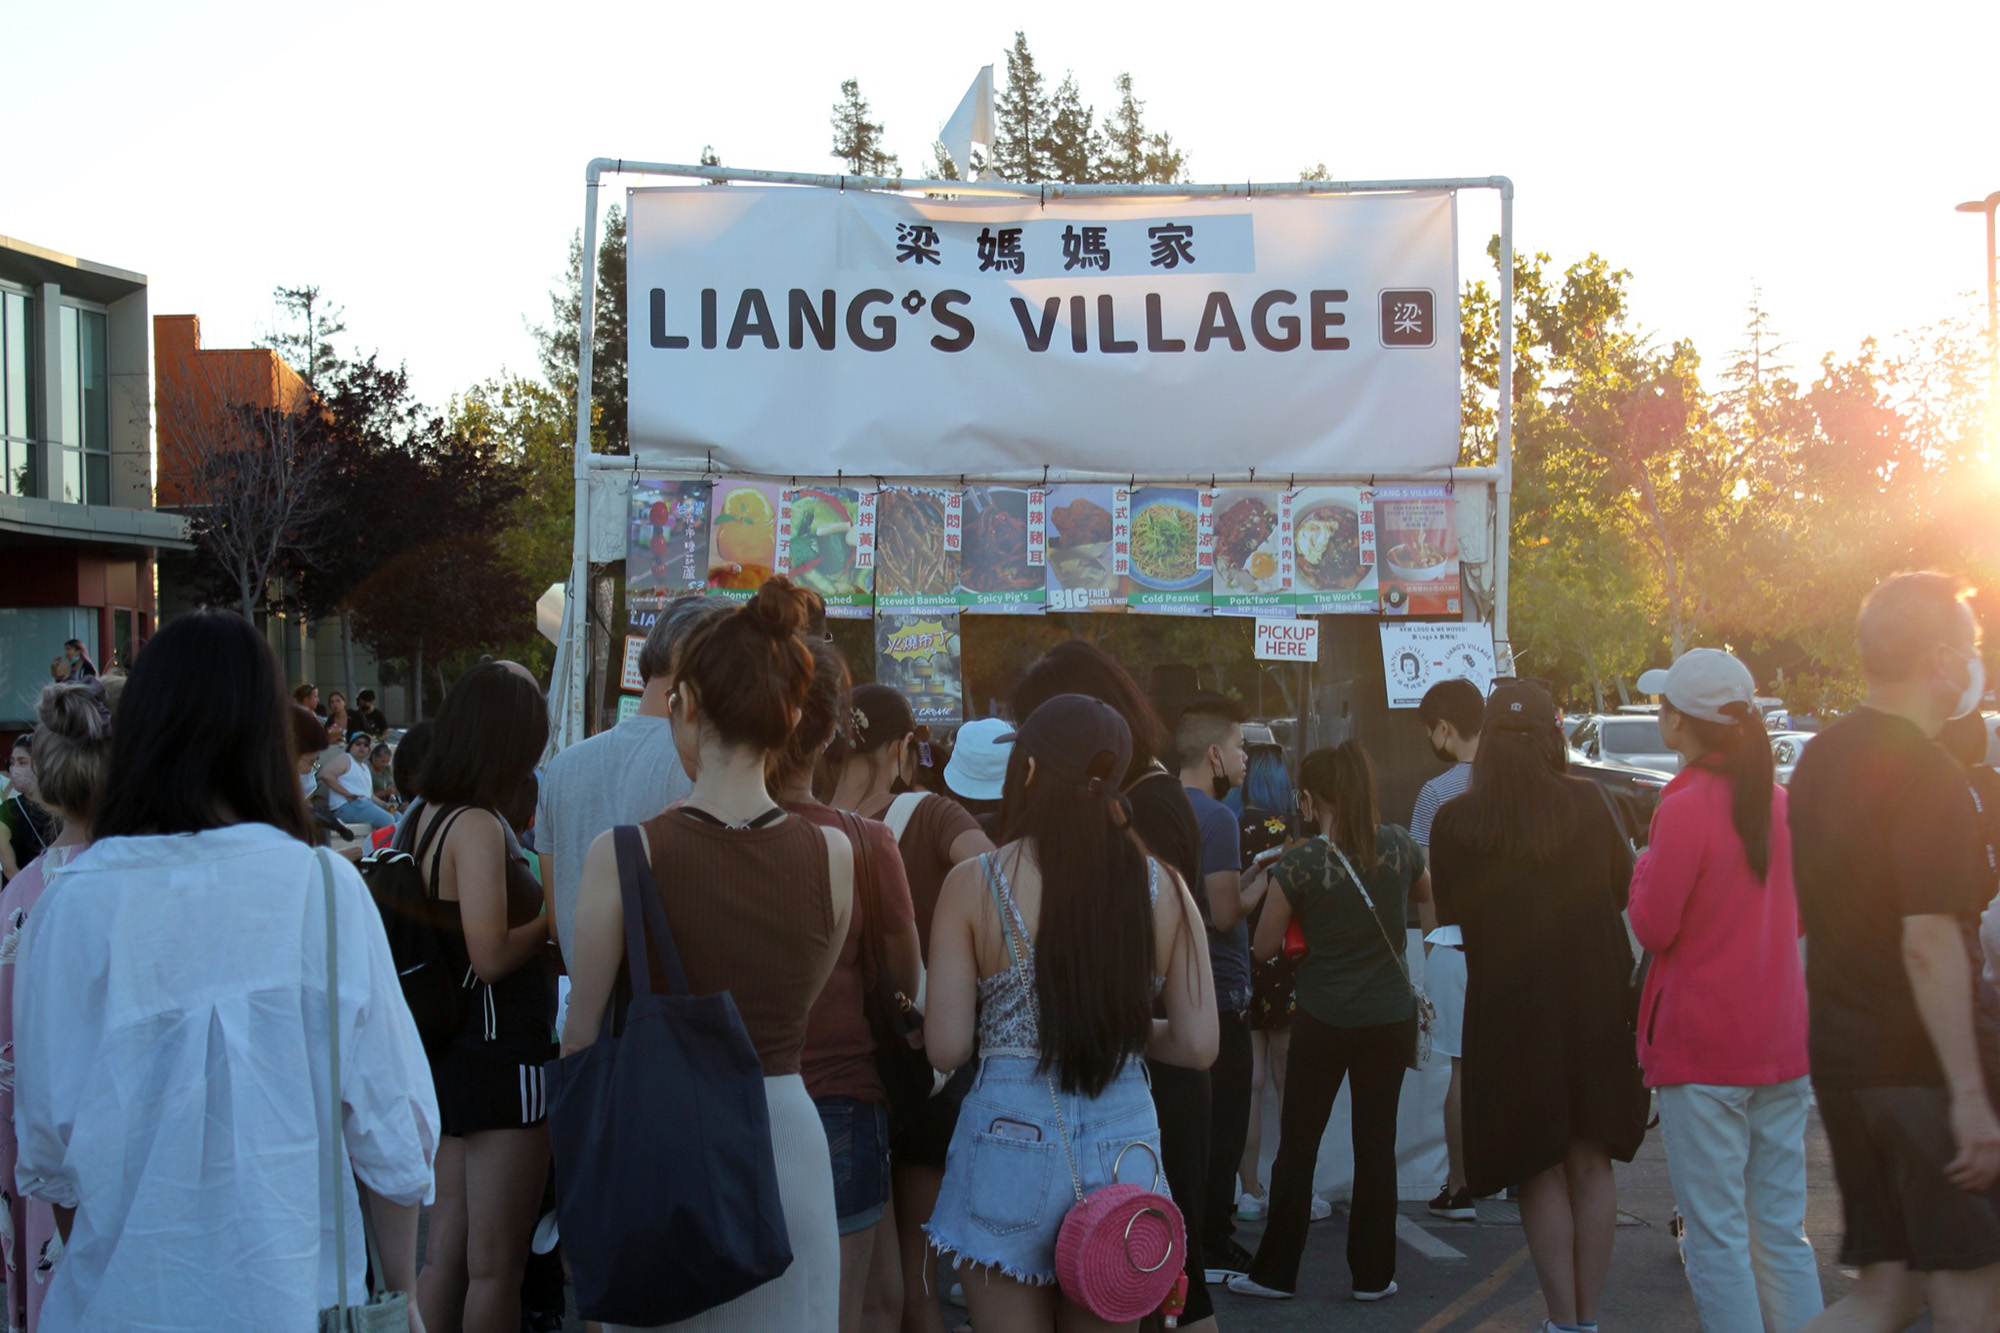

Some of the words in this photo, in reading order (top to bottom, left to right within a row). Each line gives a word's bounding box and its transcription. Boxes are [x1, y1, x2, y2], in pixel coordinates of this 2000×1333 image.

[896, 222, 1195, 275] 梁媽媽家
[1010, 289, 1350, 353] VILLAGE
[1394, 302, 1422, 335] 梁
[1410, 489, 1443, 497] VILLAGE
[857, 492, 875, 567] 涼拌黃瓜
[1029, 491, 1044, 564] 麻辣豬耳
[977, 594, 1003, 604] Spicy
[1005, 592, 1028, 603] Pig's
[1050, 588, 1089, 610] BIG
[1089, 589, 1110, 598] FRIED
[1142, 594, 1163, 604] Cold
[1165, 594, 1200, 603] Peanut
[1313, 594, 1330, 603] The
[1332, 593, 1362, 602] Works
[879, 597, 916, 606] Stewed
[917, 595, 957, 605] Bamboo
[910, 606, 941, 615] Shoots
[1003, 603, 1019, 612] Ear
[1160, 604, 1197, 613] Noodles
[1238, 605, 1251, 613] HP
[1252, 606, 1287, 616] Noodles
[1321, 604, 1334, 612] HP
[1336, 603, 1370, 612] Noodles
[1258, 625, 1316, 640] PICKUP
[1266, 641, 1307, 656] HERE
[1467, 644, 1491, 660] VILLAGE
